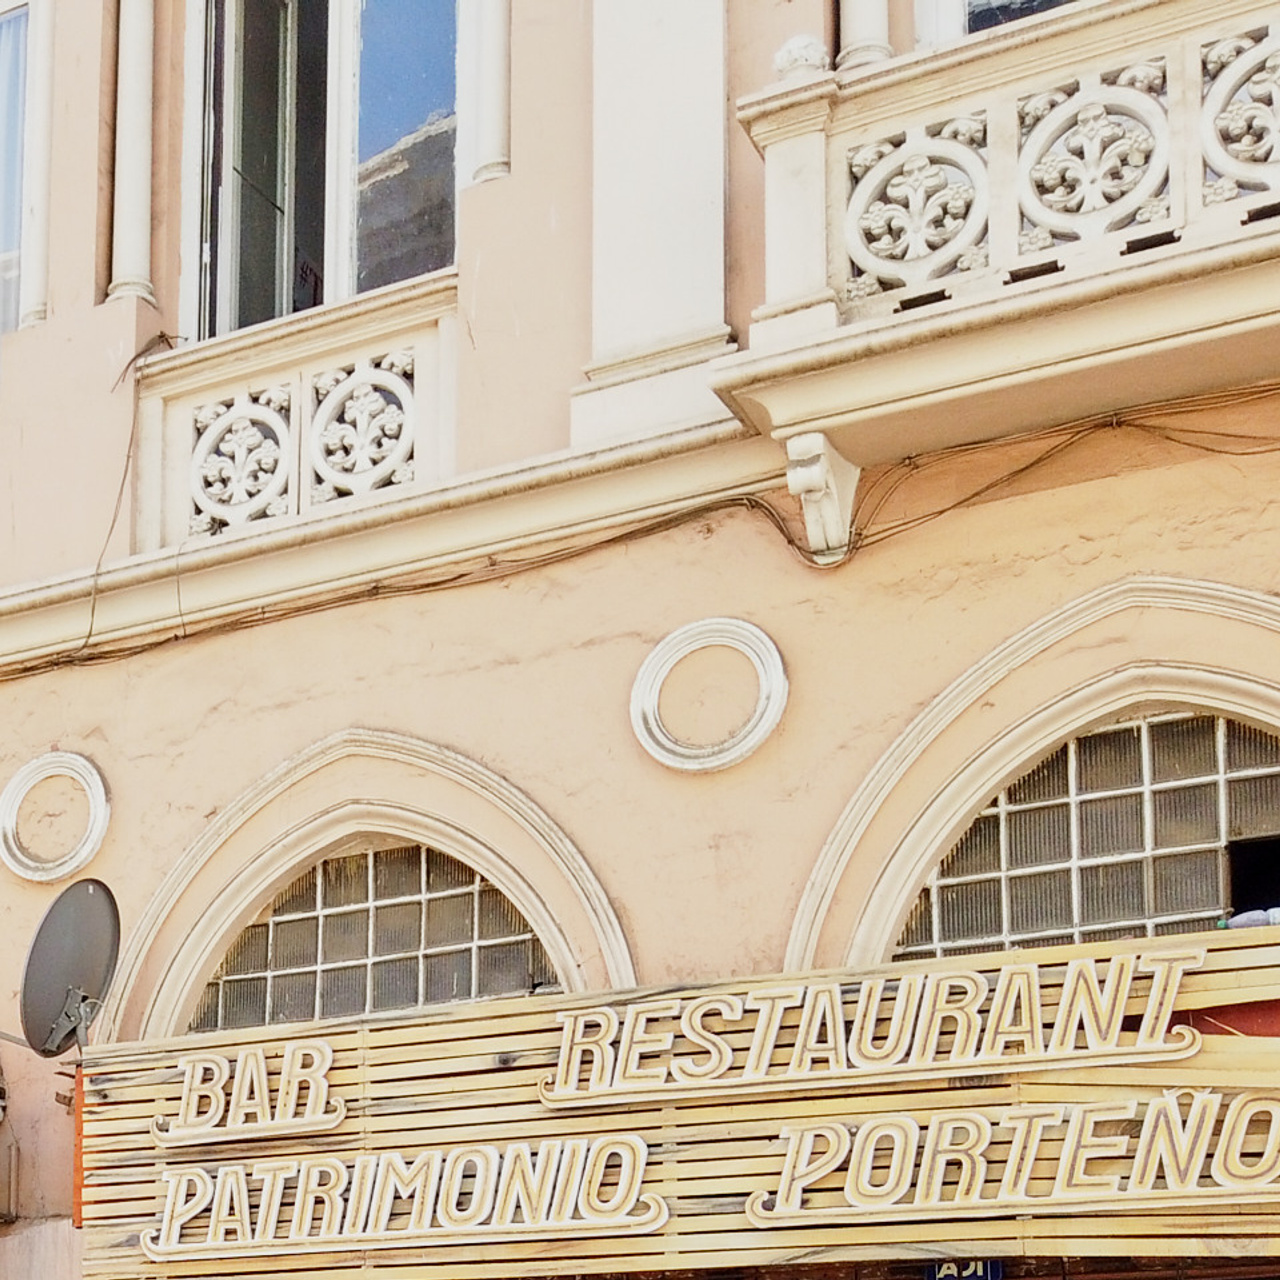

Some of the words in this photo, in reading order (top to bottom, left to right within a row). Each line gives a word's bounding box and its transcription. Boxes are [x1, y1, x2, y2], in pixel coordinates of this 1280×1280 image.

[170, 1038, 340, 1138] BAR
[550, 949, 1208, 1096] RESTAURANT
[153, 1134, 655, 1252] PATRIMONIO
[760, 1087, 1280, 1220] PORTEÑO
